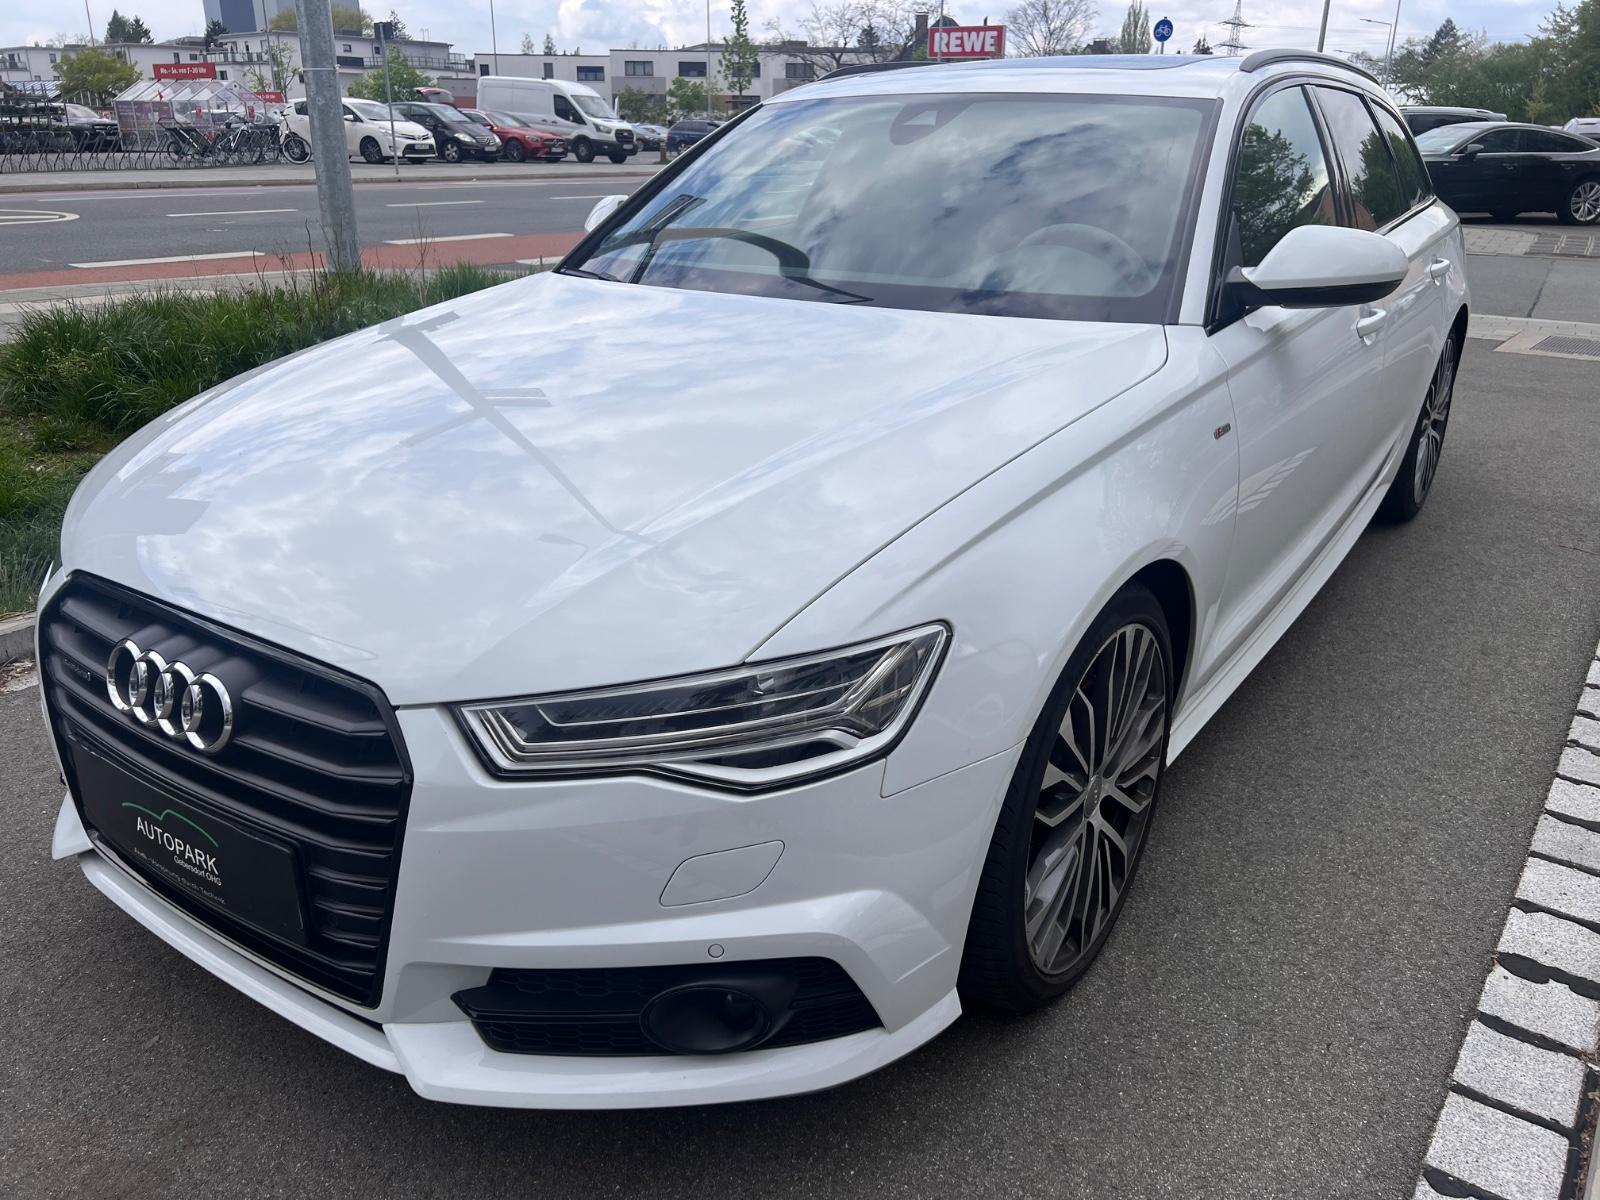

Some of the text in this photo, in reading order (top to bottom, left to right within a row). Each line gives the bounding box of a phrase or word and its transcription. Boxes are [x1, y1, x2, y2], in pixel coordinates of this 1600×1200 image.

[933, 31, 998, 52] REWE
[137, 816, 219, 875] AUTOPARK
[205, 872, 222, 886] OHG
